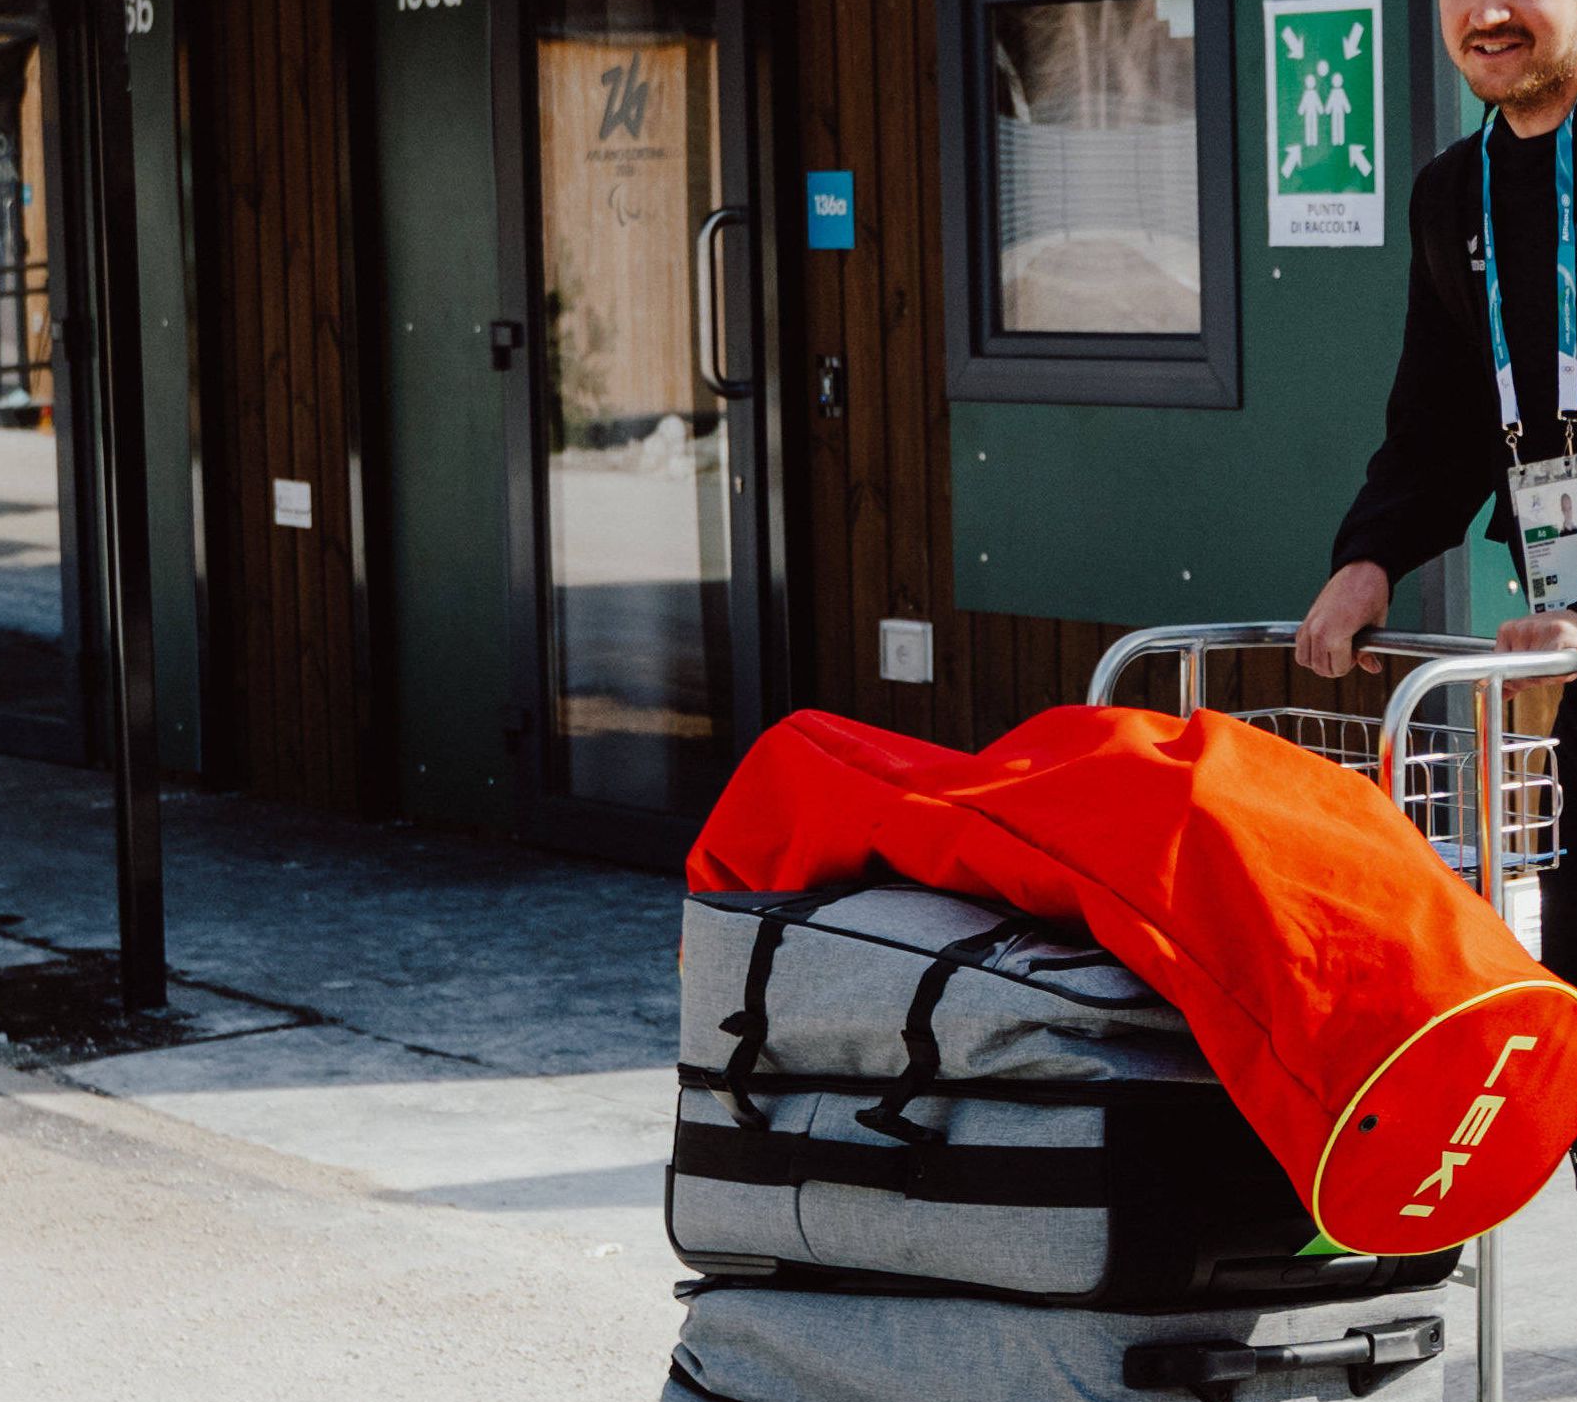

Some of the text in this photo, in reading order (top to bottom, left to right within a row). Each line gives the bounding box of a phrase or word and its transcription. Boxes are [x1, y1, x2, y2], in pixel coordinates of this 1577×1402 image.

[1307, 203, 1346, 216] PUNTO
[1291, 221, 1361, 233] DI RACCOLTA
[1561, 208, 1571, 243] Allianz
[1400, 1035, 1538, 1217] LEKI
